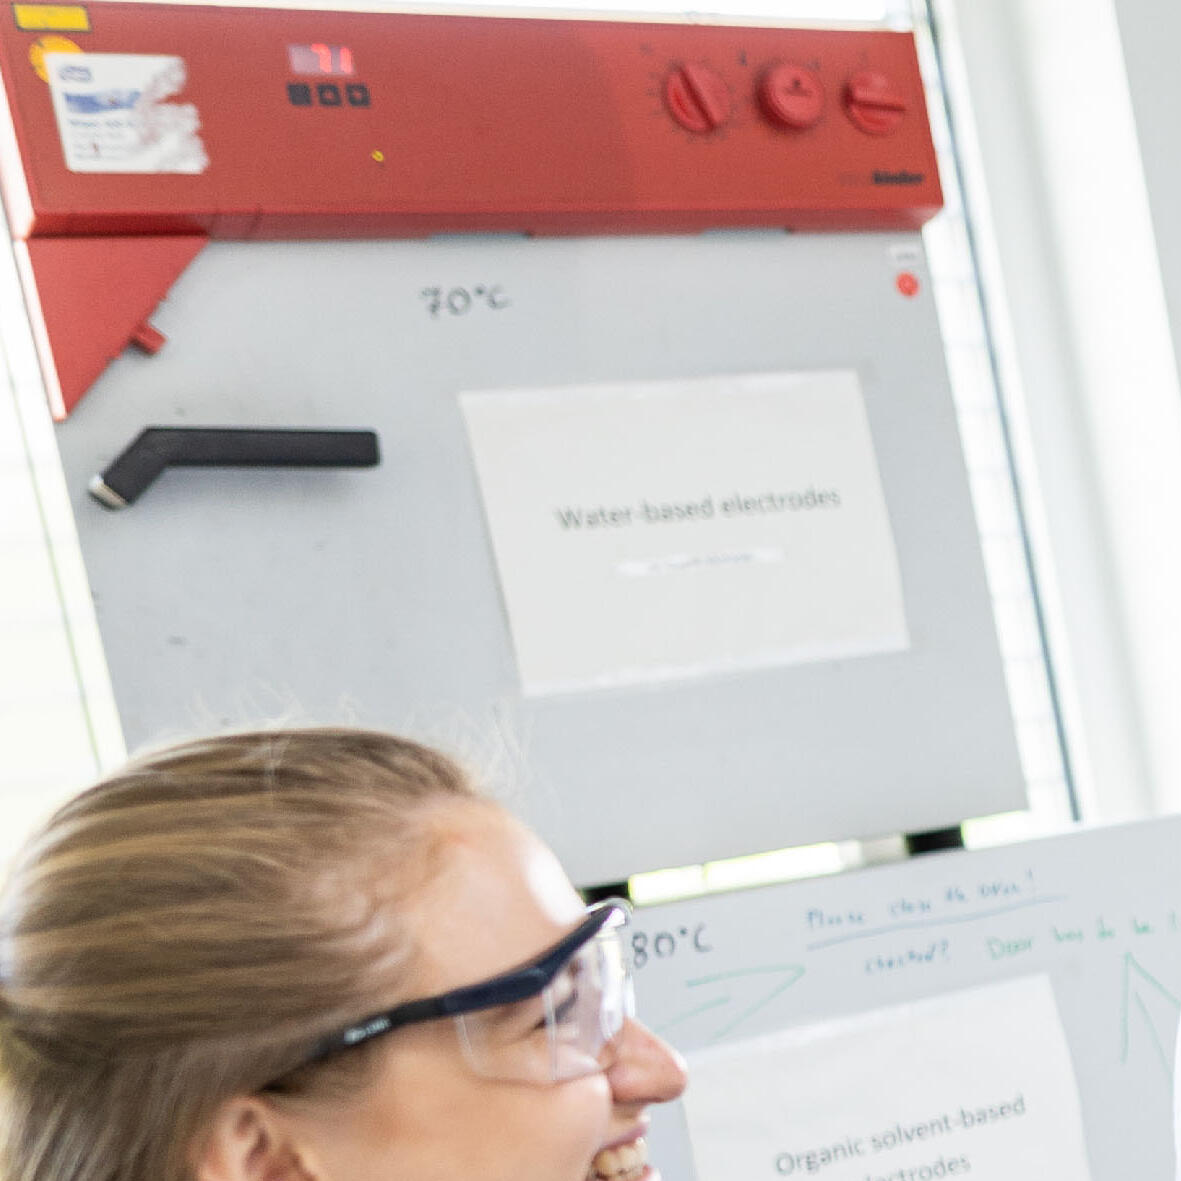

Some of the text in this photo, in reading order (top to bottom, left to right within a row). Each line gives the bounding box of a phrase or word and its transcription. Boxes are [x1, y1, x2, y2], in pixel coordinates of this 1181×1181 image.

[420, 283, 512, 319] 70°C
[556, 484, 842, 530] Water-based electrodes
[775, 1093, 1027, 1176] Organic solvent-based
